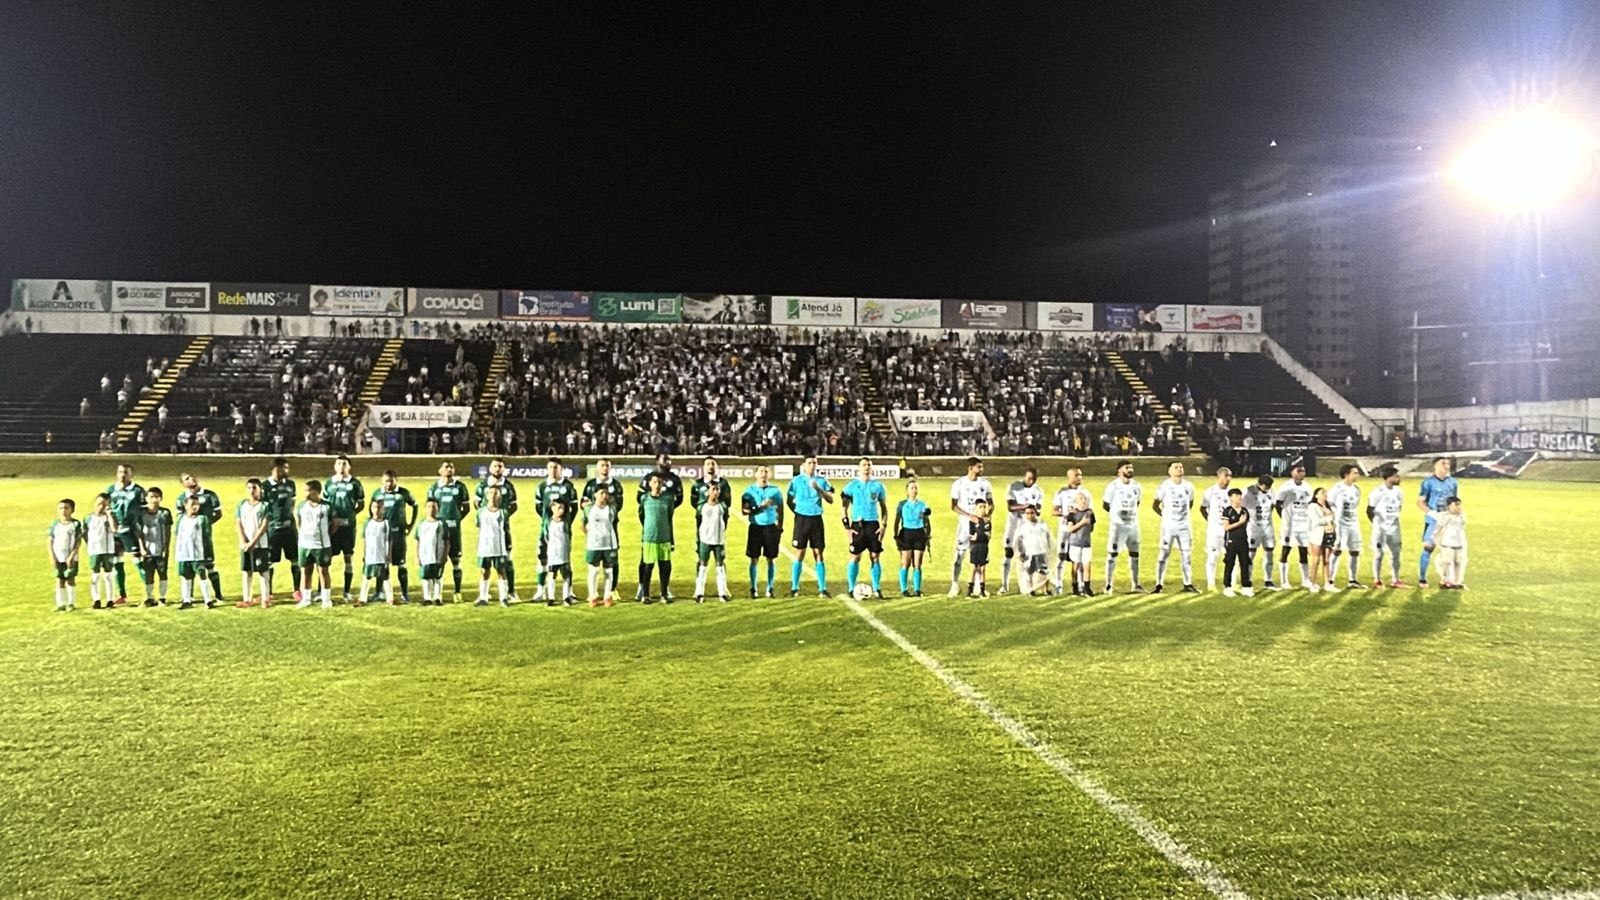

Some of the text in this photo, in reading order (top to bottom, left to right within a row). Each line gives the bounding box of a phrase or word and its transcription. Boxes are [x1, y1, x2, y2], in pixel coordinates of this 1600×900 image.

[29, 301, 96, 310] AGRONORTE
[540, 300, 575, 309] Instituto
[620, 299, 656, 311] Lumi
[801, 303, 829, 312] Atend
[395, 411, 417, 421] SEJA
[915, 416, 934, 425] SEJA
[1539, 433, 1594, 452] REGGAE
[512, 467, 549, 477] ACADE
